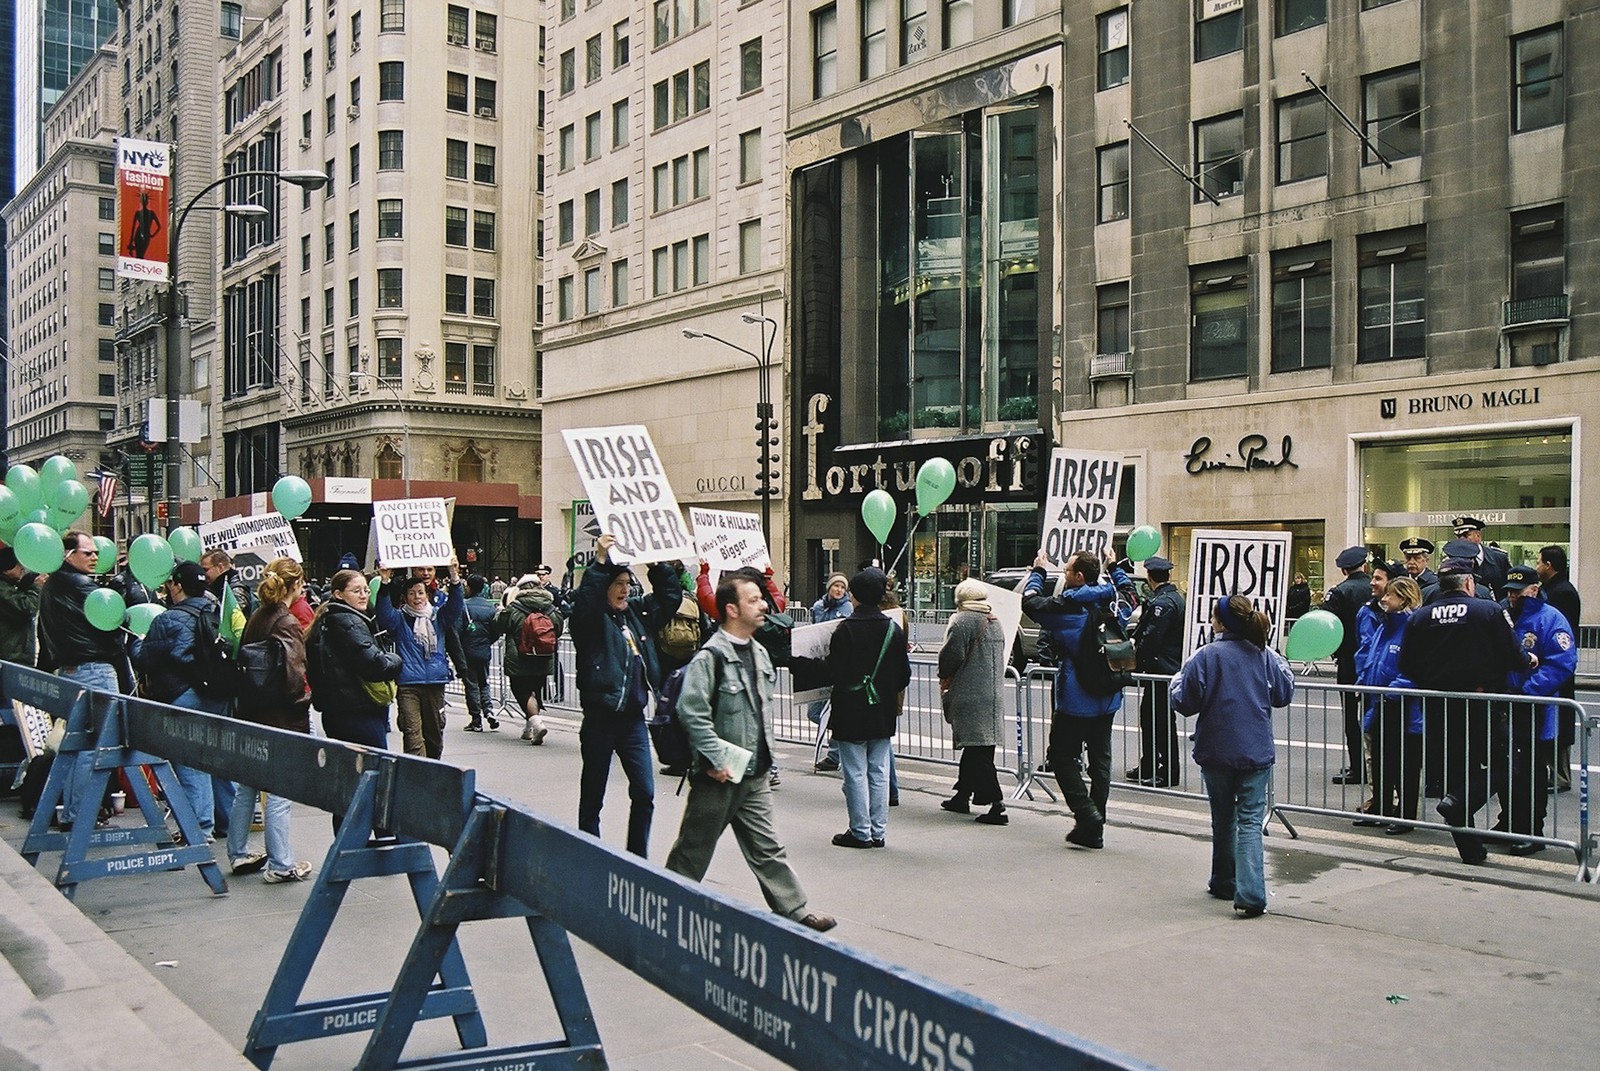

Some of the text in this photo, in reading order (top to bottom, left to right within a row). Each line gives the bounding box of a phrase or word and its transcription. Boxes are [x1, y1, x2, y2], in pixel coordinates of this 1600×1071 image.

[123, 149, 166, 168] NYC
[125, 171, 164, 187] fashion
[123, 262, 163, 276] InStyle
[1408, 393, 1473, 414] BRUNO
[1481, 387, 1540, 408] MAGLI
[298, 418, 357, 438] ELIZABETH ARDEN
[802, 392, 1032, 500] fortuoff
[574, 435, 660, 480] IRISH
[696, 475, 745, 493] GUCCI
[1052, 458, 1118, 500] IRISH
[609, 480, 660, 506] AND
[379, 501, 441, 512] ANOTHER
[1058, 501, 1107, 523] AND
[235, 515, 290, 536] HOMOPHOBIA
[381, 511, 445, 533] QUEER
[694, 512, 762, 532] RUDY & HILLARY
[203, 533, 217, 546] WE
[394, 532, 435, 541] FROM
[607, 509, 687, 557] QUEER
[700, 534, 728, 553] Who's The
[385, 542, 450, 560] IRELAND
[720, 539, 748, 560] Bigger
[1198, 542, 1281, 597] IRISH
[1431, 603, 1468, 619] NYPD
[1580, 769, 1588, 811] NYPD
[105, 831, 134, 842] DEPT.
[107, 853, 177, 872] POLICE DEPT.
[607, 871, 976, 1071] POLICE LINE DO NOT CROSS
[322, 1009, 377, 1031] POLICE
[704, 979, 796, 1050] POLICE DEPT.
